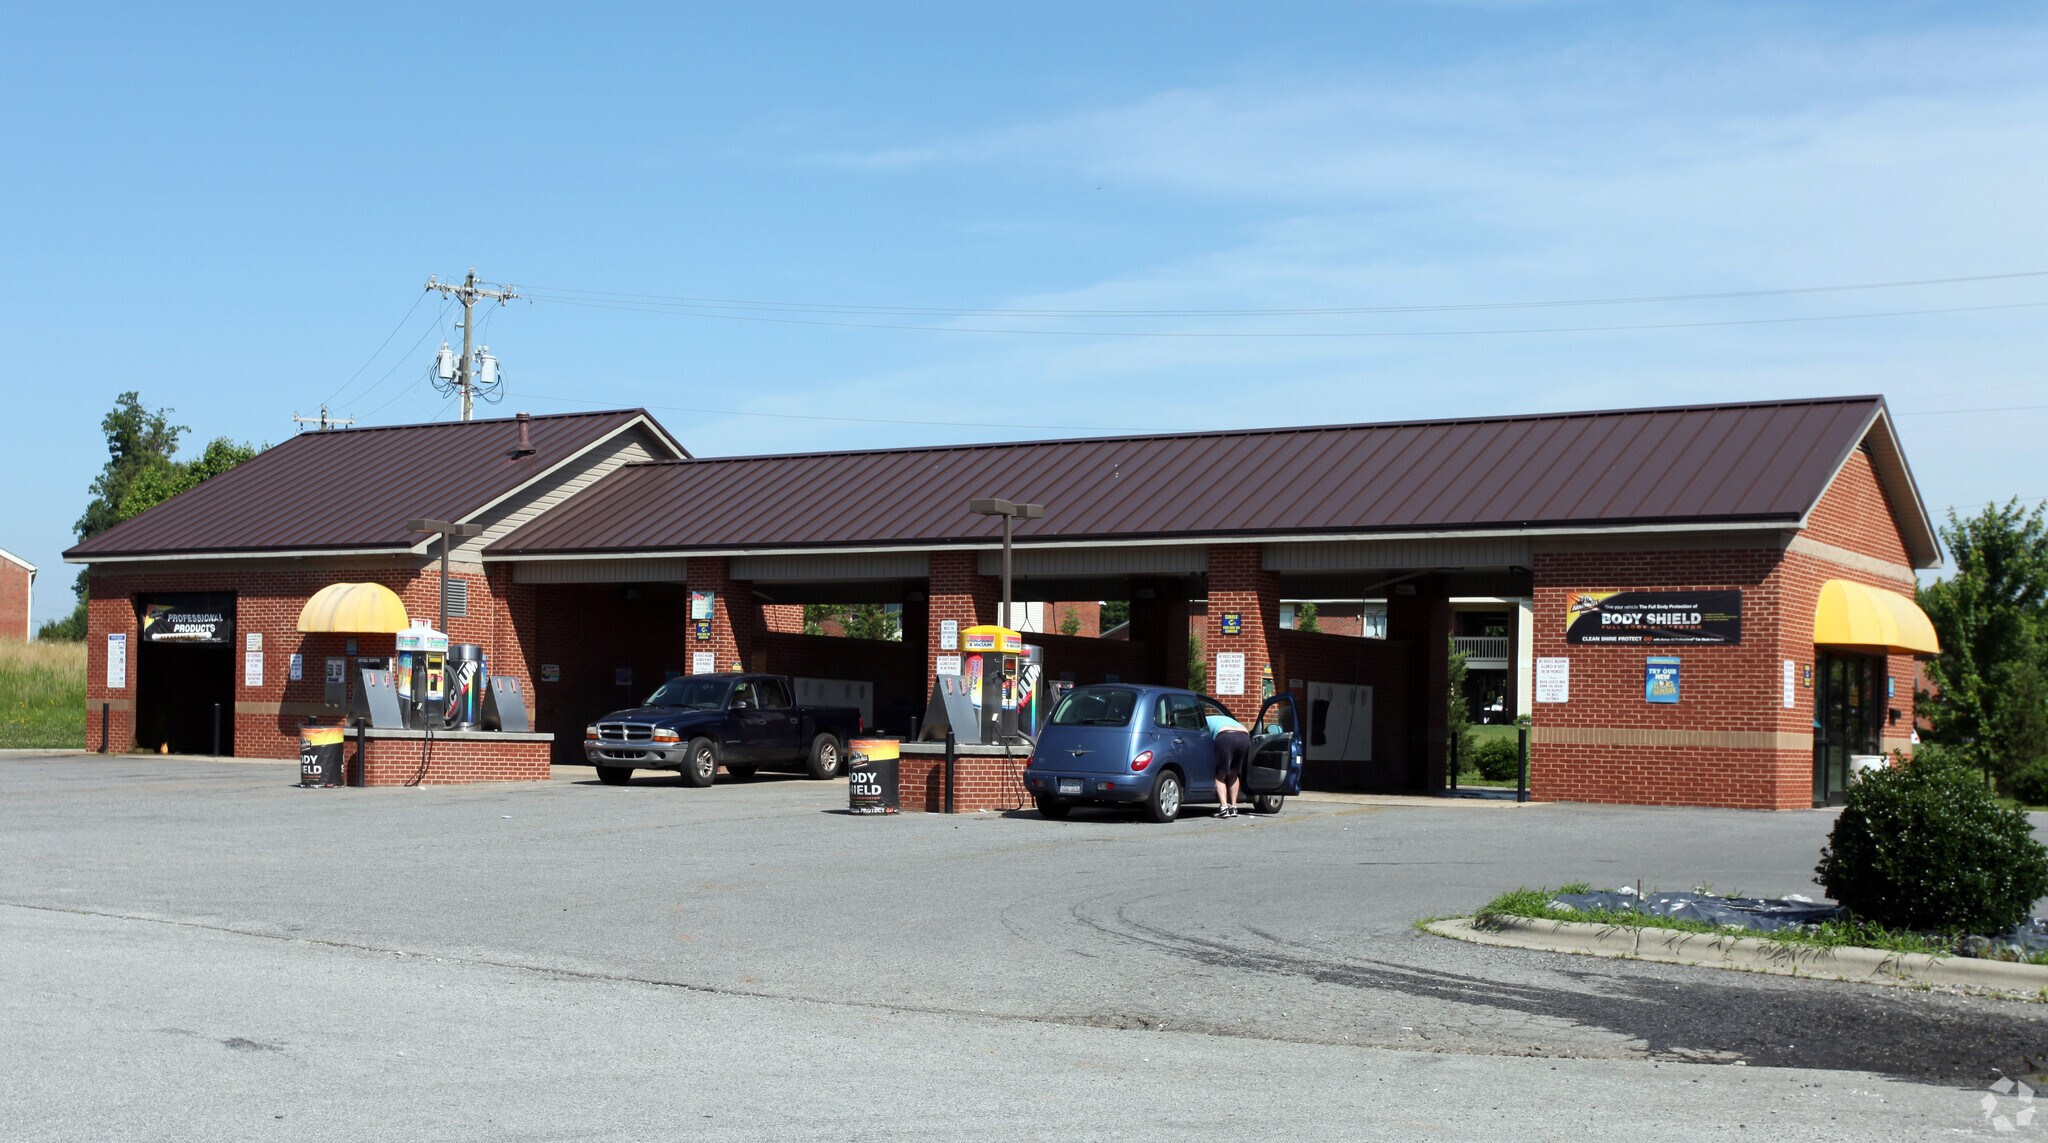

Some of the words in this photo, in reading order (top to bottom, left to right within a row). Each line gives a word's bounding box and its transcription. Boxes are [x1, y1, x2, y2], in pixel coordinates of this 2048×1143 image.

[167, 613, 223, 622] PROFESSIONAL
[1601, 613, 1643, 625] BODY
[1646, 613, 1702, 625] SHIELD
[173, 624, 216, 633] PRODUCTS
[303, 765, 322, 774] ELD
